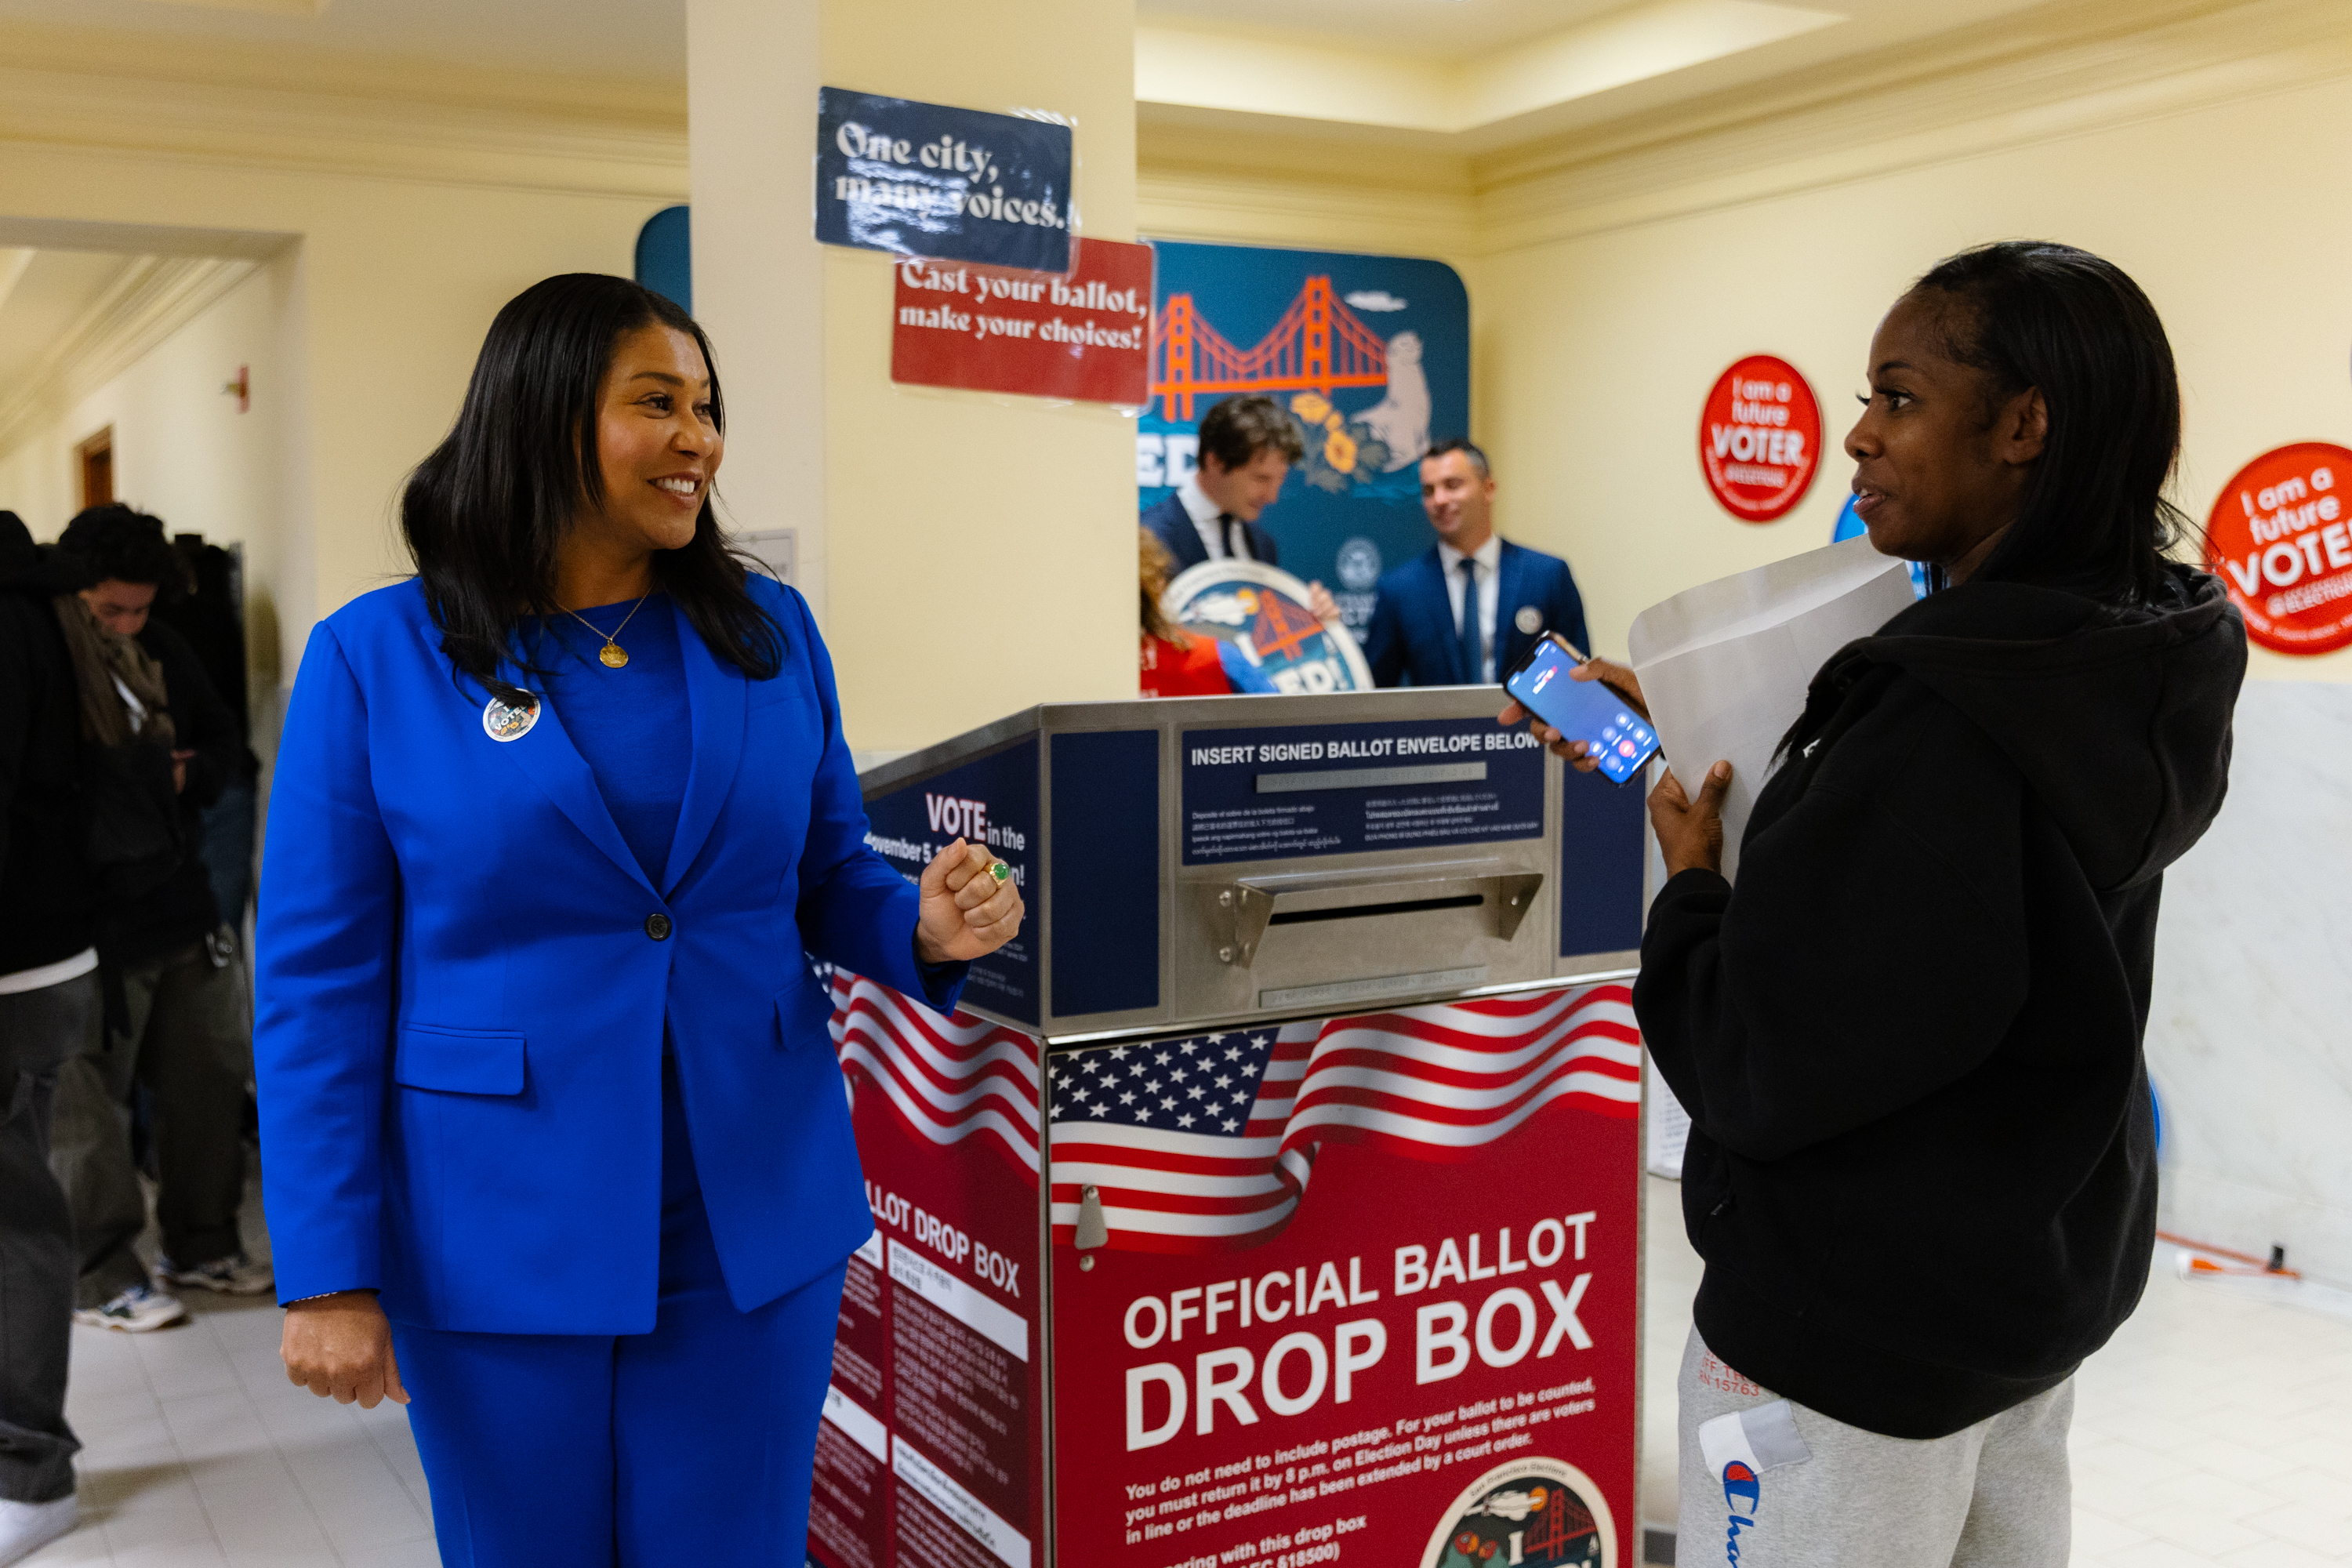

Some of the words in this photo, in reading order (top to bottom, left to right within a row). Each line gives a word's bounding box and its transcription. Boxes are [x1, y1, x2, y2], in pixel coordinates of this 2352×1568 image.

[836, 121, 912, 165] One
[920, 135, 999, 183] city,
[834, 174, 941, 220] many
[947, 185, 1066, 230] voices.
[901, 258, 971, 295] Cast
[975, 274, 1046, 304] your
[1050, 278, 1148, 320] ballot,
[898, 304, 971, 332] make
[975, 318, 1036, 340] your
[1039, 317, 1142, 350] choices!
[1731, 400, 1790, 428] future
[1732, 375, 1743, 401] I
[1742, 379, 1775, 401] am
[1775, 382, 1792, 403] a
[1711, 423, 1805, 467] VOTER
[2241, 489, 2255, 517] I
[2258, 476, 2307, 510] am
[2310, 466, 2334, 492] a
[2249, 495, 2341, 546] future
[2226, 517, 2352, 597] VOTE
[1190, 746, 1257, 766] INSERT
[1258, 742, 1324, 763] SIGNED
[1327, 739, 1393, 759] BALLOT
[1396, 734, 1481, 756] ENVELOPE
[1484, 731, 1541, 751] BELOW
[926, 792, 986, 841] VOTE
[987, 821, 1000, 846] in
[1002, 825, 1025, 851] the
[865, 1179, 911, 1232] LLOT
[914, 1207, 970, 1265] DROP
[974, 1241, 1020, 1298] BOX
[1123, 1256, 1379, 1349] OFFICIAL
[1395, 1210, 1596, 1296] BALLOT
[1125, 1318, 1387, 1452] DROP
[1416, 1272, 1593, 1385] BOX
[1715, 1377, 1759, 1396] 15763
[1125, 1481, 1156, 1501] You
[1160, 1475, 1181, 1494] do
[1185, 1467, 1210, 1486] not
[1214, 1456, 1252, 1479] need
[1255, 1454, 1272, 1470] to
[1275, 1439, 1329, 1465] include
[1331, 1426, 1392, 1454] postage.
[1396, 1417, 1421, 1436] For
[1423, 1410, 1455, 1432] your
[1458, 1399, 1497, 1421] ballot
[1500, 1396, 1515, 1411] to
[1516, 1392, 1535, 1407] be
[1125, 1504, 1156, 1526] you
[1159, 1491, 1199, 1515] must
[1201, 1481, 1247, 1504] return
[1250, 1476, 1261, 1492] it
[1264, 1471, 1283, 1490] by
[1286, 1467, 1295, 1483] 8
[1298, 1463, 1330, 1483] p.m.
[1333, 1457, 1352, 1472] on
[1355, 1442, 1412, 1466] Election
[1414, 1433, 1442, 1452] Day
[1443, 1422, 1489, 1444] unless
[1491, 1413, 1526, 1433] there
[1529, 1408, 1551, 1424] are
[1553, 1399, 1595, 1419] voters
[1125, 1528, 1142, 1545] in
[1144, 1519, 1174, 1541] line
[1176, 1515, 1193, 1531] or
[1196, 1508, 1221, 1527] the
[1224, 1491, 1287, 1521] deadline
[1290, 1484, 1316, 1504] has
[1319, 1475, 1355, 1497] been
[1356, 1454, 1421, 1487] extended
[1423, 1451, 1442, 1472] by
[1443, 1451, 1454, 1465] a
[1455, 1439, 1491, 1461] court
[1493, 1432, 1534, 1453] order.
[1722, 1460, 1760, 1568] Cha
[1220, 1541, 1256, 1564] with
[1259, 1534, 1291, 1555] this
[1294, 1524, 1334, 1545] drop
[1336, 1515, 1367, 1535] box
[1508, 1530, 1525, 1566] I
